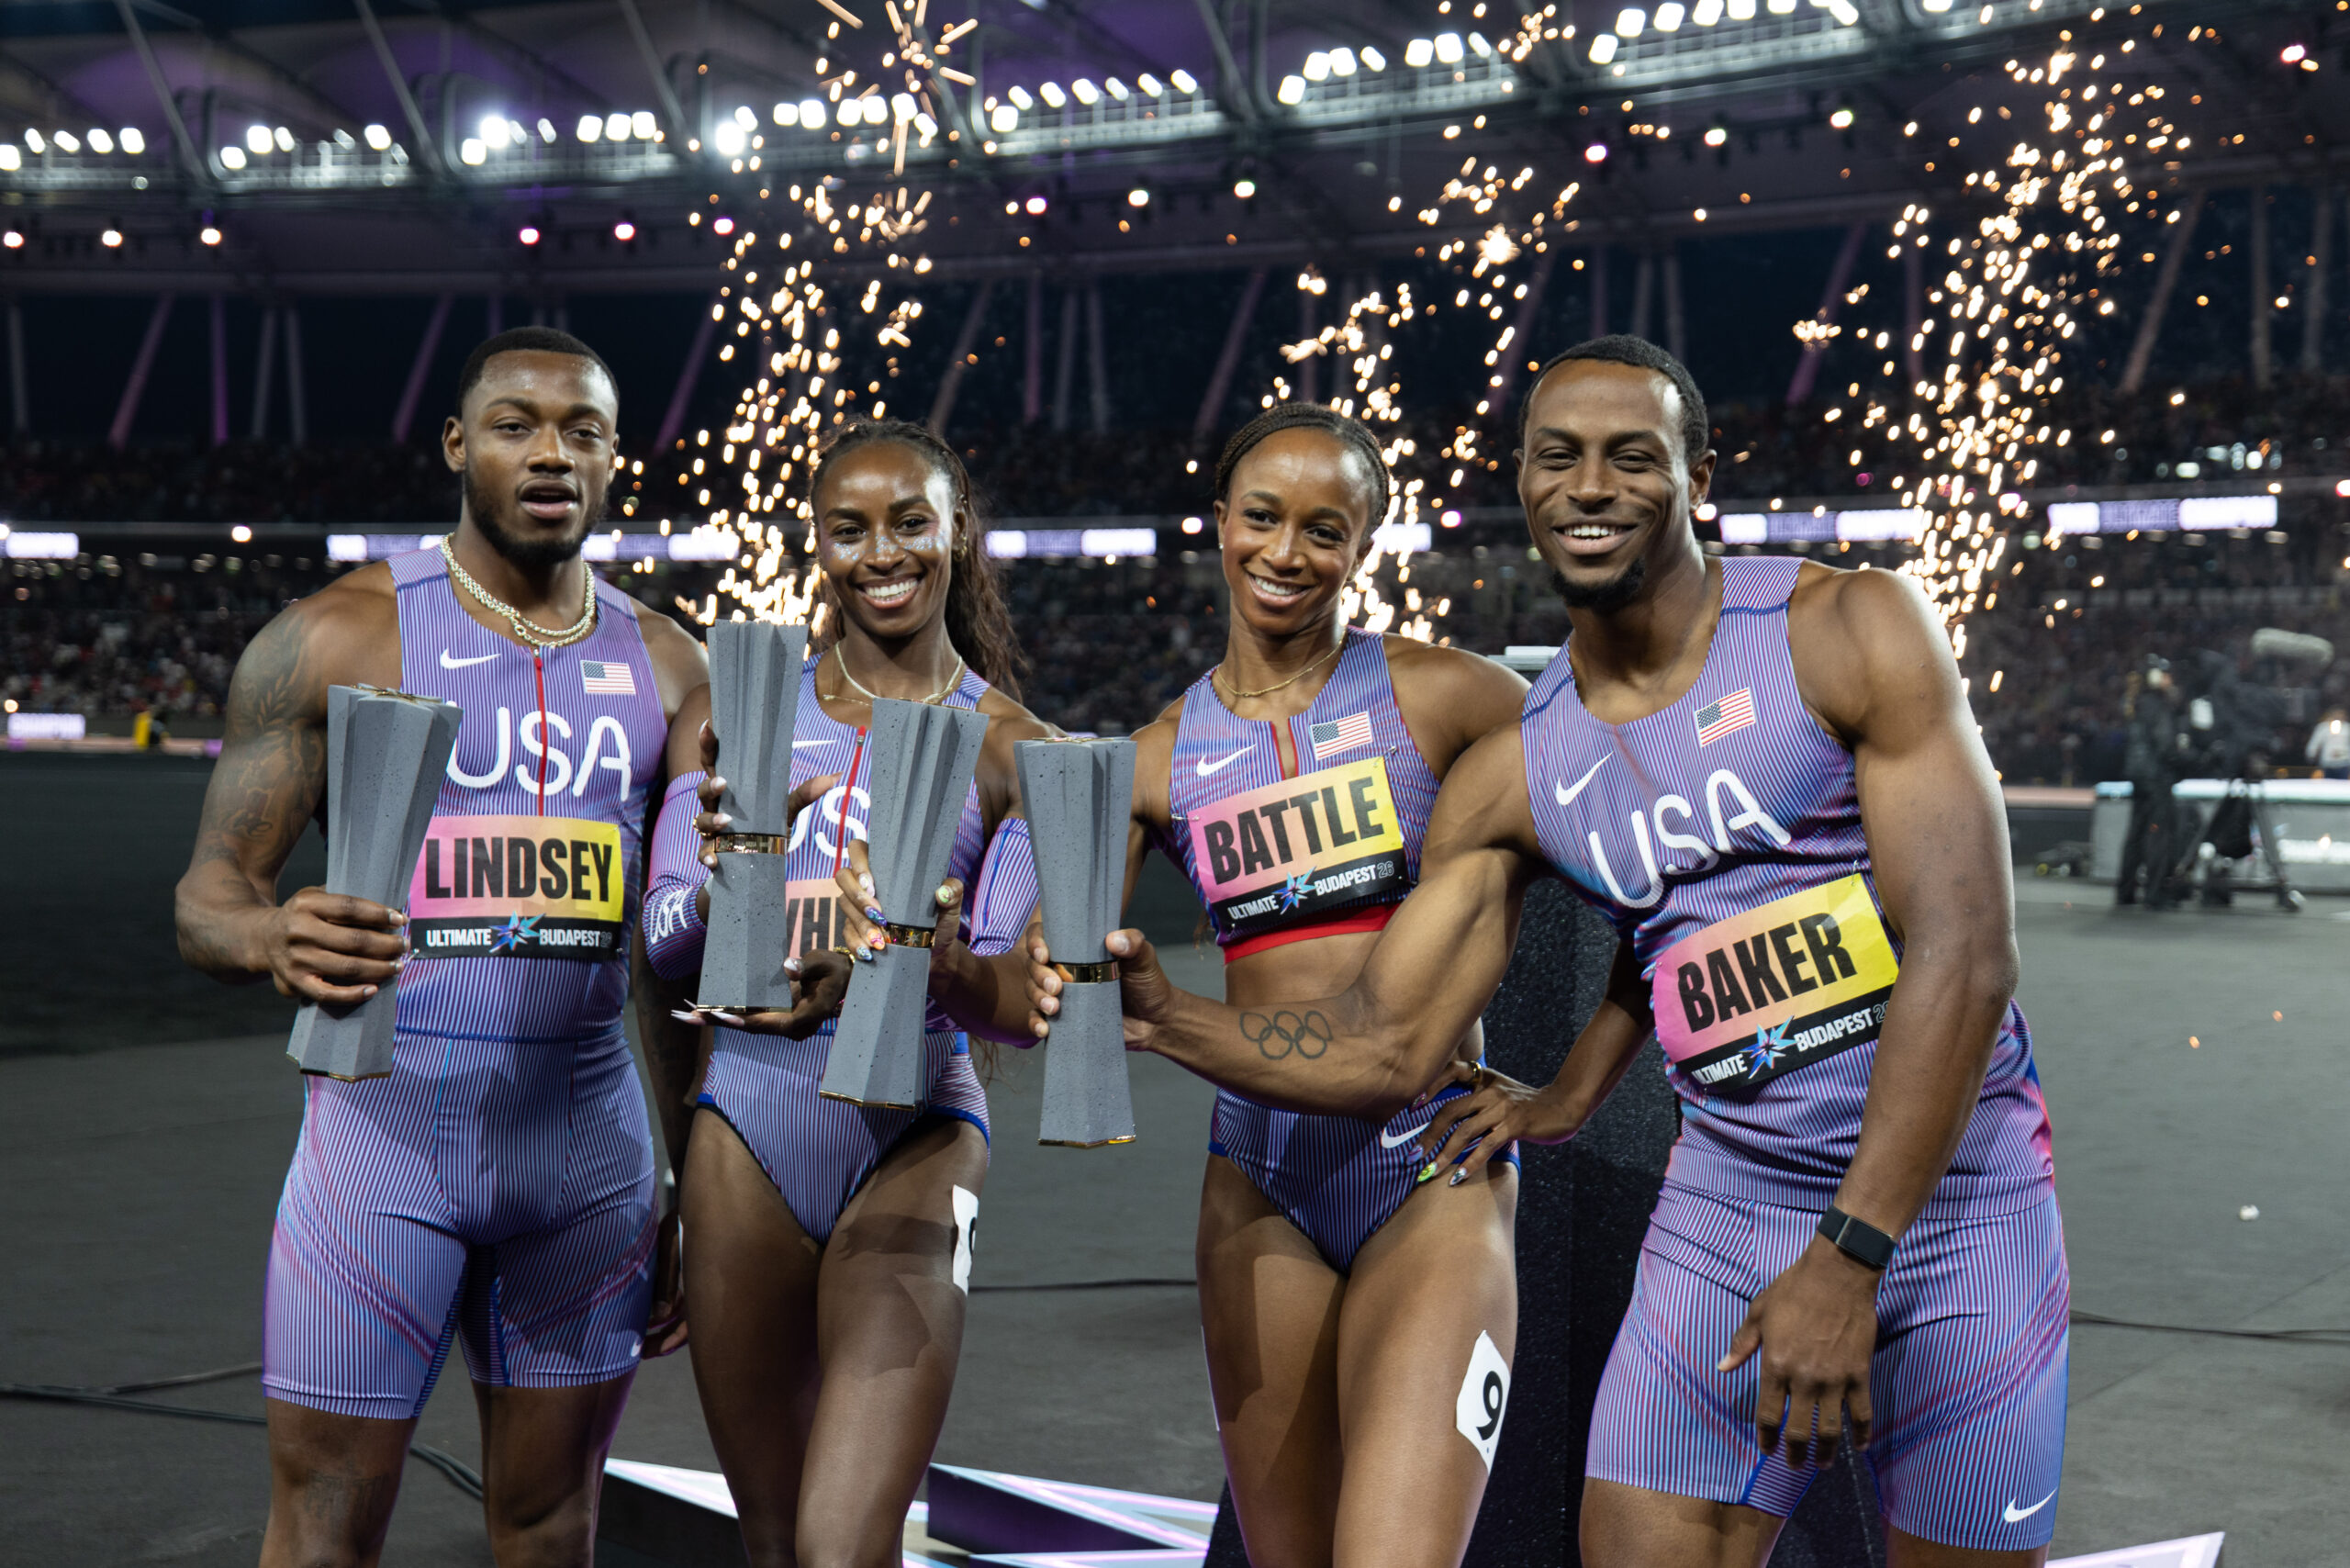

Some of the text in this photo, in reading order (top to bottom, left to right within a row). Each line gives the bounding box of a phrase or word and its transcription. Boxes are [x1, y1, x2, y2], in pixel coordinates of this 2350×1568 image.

[445, 700, 632, 802] USA
[1203, 776, 1385, 886] BATTLE
[1588, 768, 1792, 909] USA
[425, 837, 613, 902] LINDSEY
[1227, 861, 1395, 920] ULTIMATE BUDAPEST 26
[426, 928, 492, 947] ULTIMATE
[539, 928, 601, 947] BUDAPEST
[650, 886, 694, 944] USA
[1677, 912, 1858, 1034] BAKER
[1691, 1053, 1749, 1085] ULTIMATE
[1793, 1007, 1874, 1053] BUDAPEST
[1476, 1371, 1503, 1440] 9
